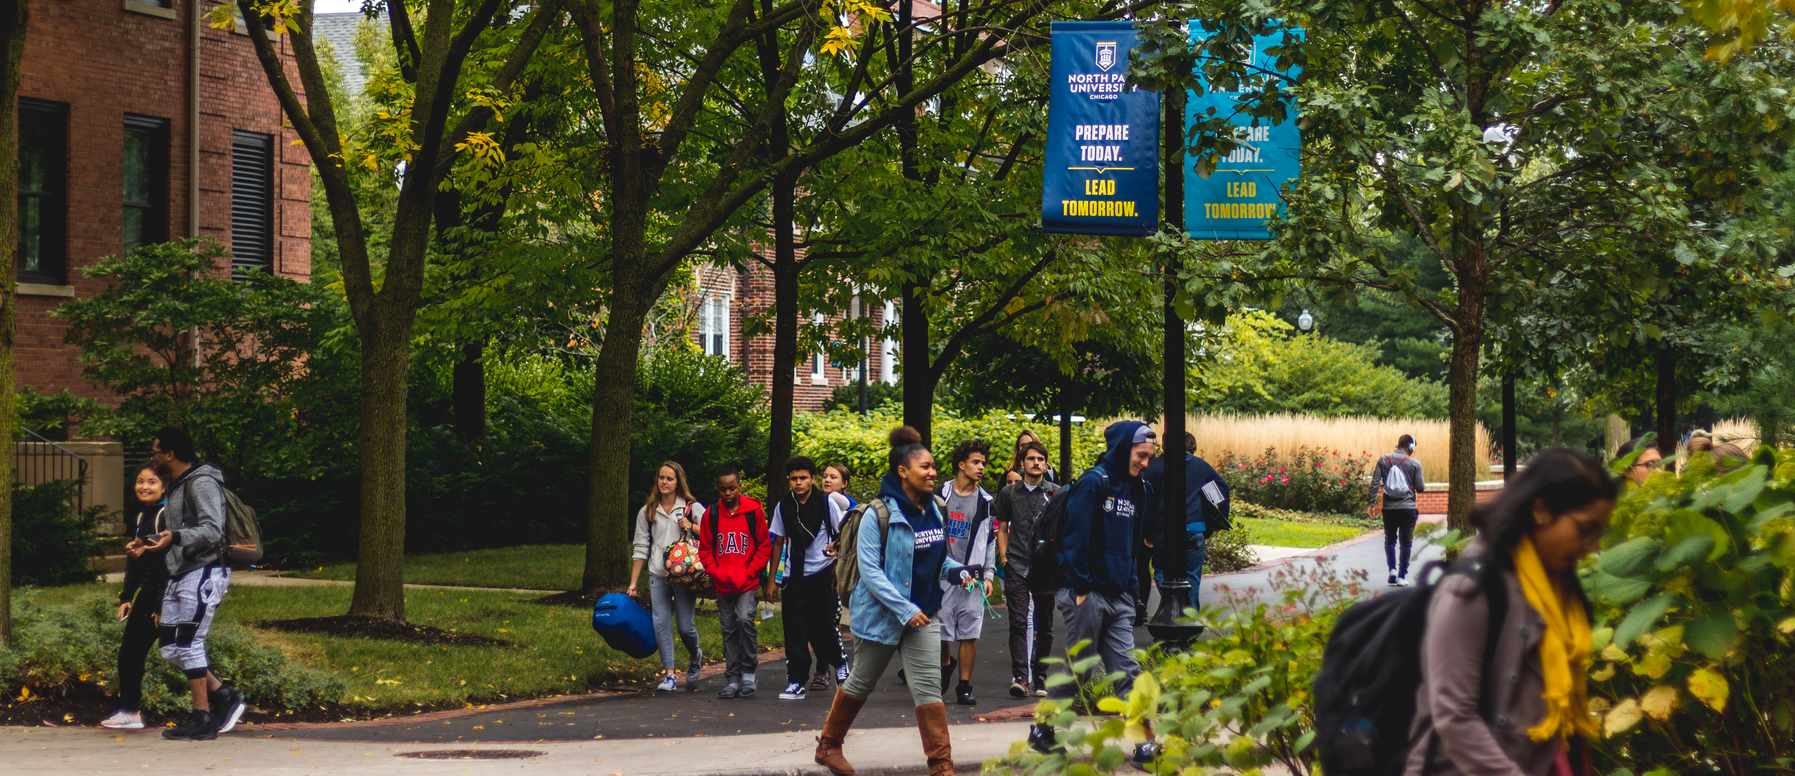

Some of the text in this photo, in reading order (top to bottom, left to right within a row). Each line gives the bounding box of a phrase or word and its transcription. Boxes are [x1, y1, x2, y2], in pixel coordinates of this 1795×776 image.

[1068, 74, 1126, 83] NORTH PA
[1070, 83, 1137, 93] UNIVERSIY
[1075, 124, 1129, 141] PREPARE
[1080, 145, 1123, 162] TODAY.
[1085, 179, 1116, 196] LEAD
[1226, 182, 1257, 198] LEAD
[1062, 200, 1139, 217] TOMORROW.
[950, 511, 965, 521] NIKE
[914, 530, 933, 538] NORTH
[947, 527, 966, 537] AMPS
[717, 532, 749, 556] GAP
